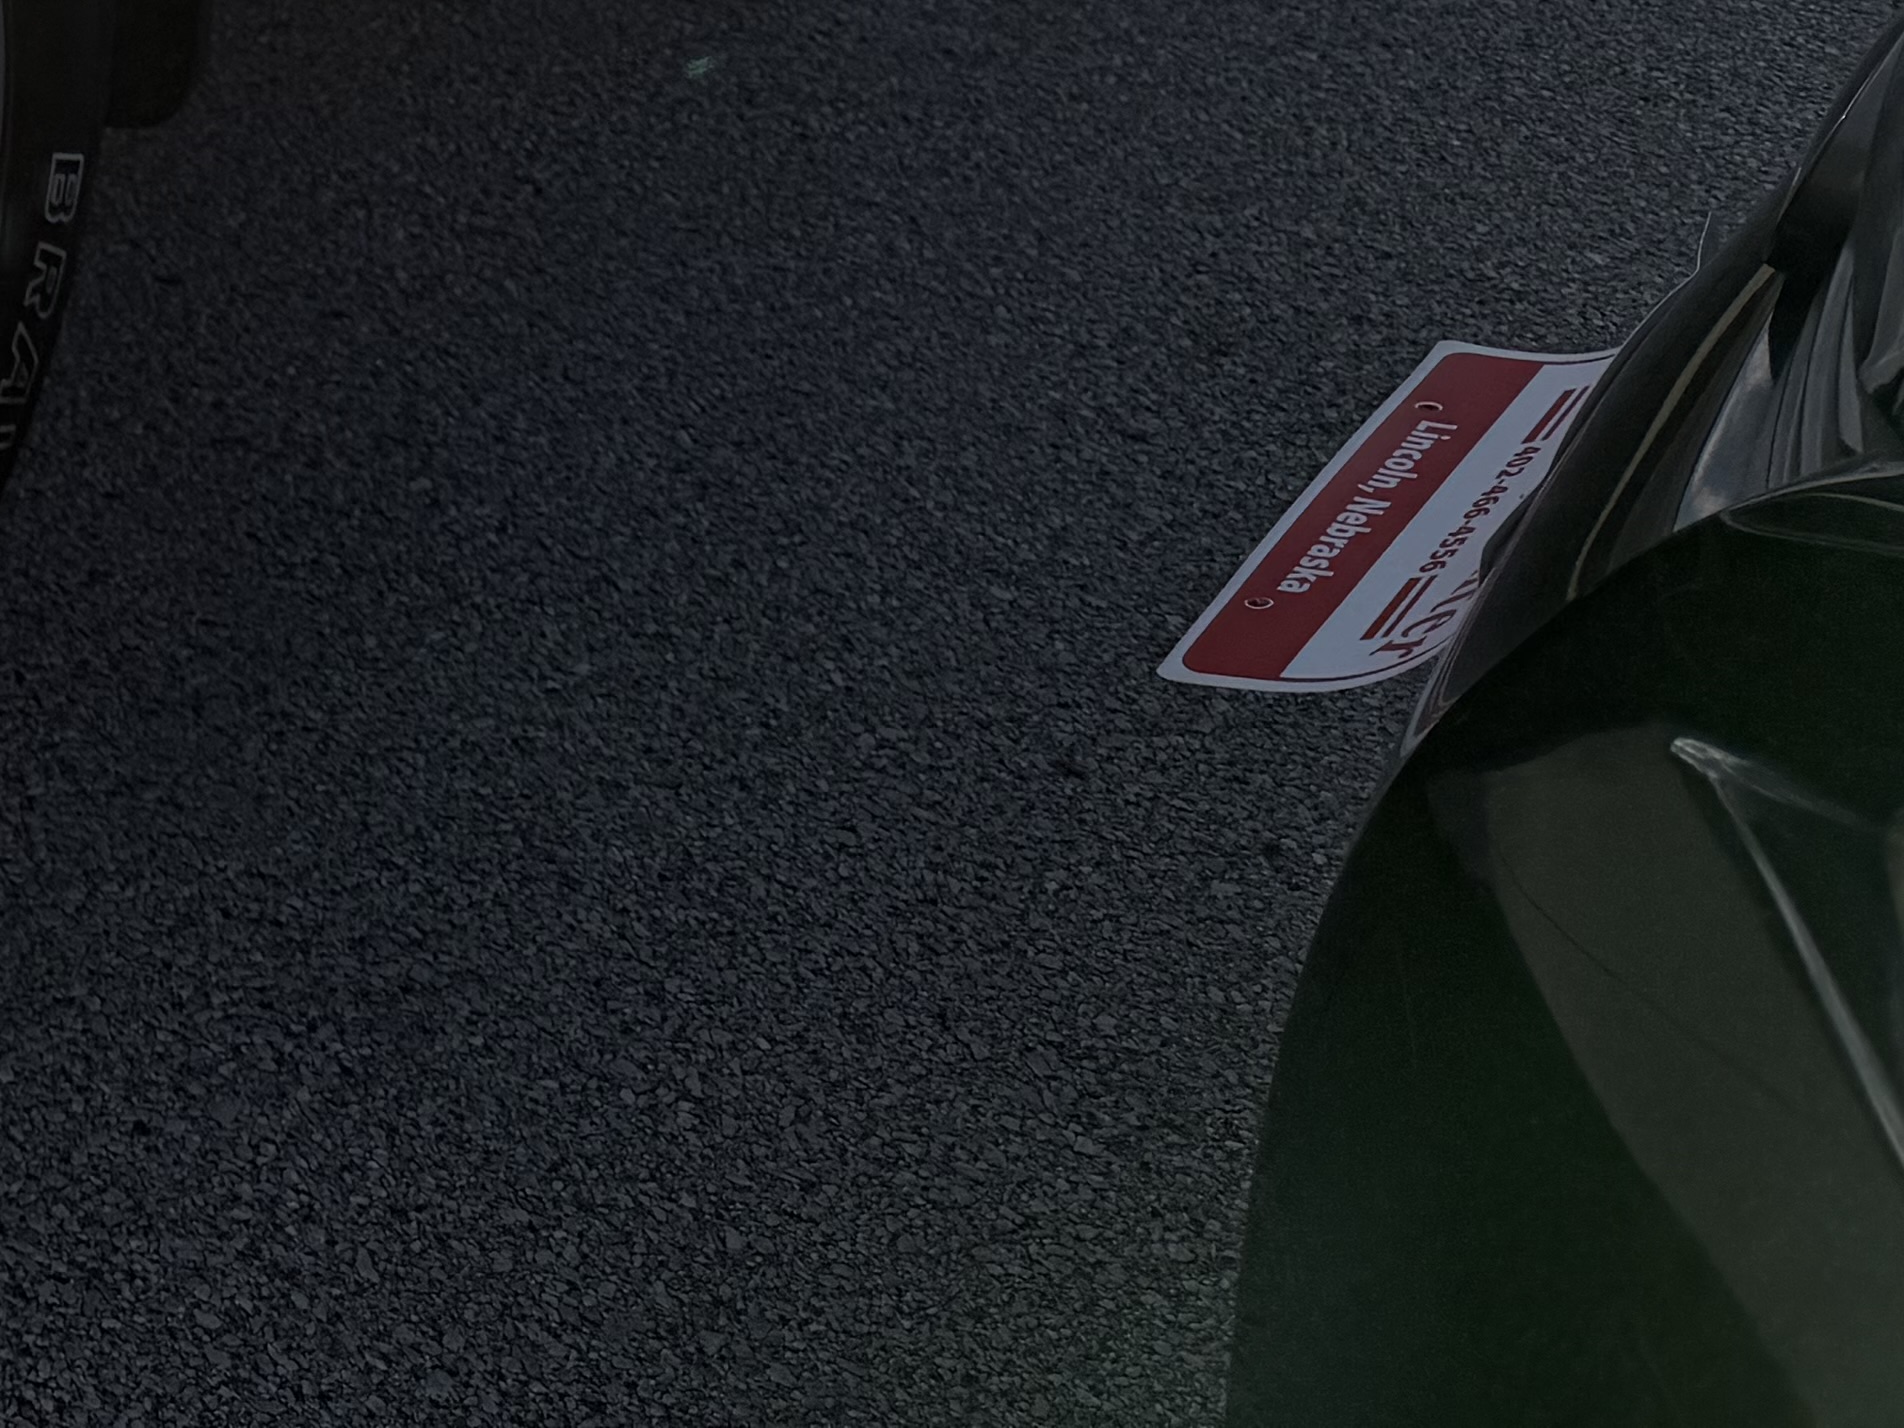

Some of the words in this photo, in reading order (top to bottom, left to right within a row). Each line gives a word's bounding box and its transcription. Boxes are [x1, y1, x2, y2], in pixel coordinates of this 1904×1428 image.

[1356, 419, 1459, 494] Lincoln,
[1276, 495, 1393, 594] Nebraska
[1418, 445, 1543, 574] 402-466-4556
